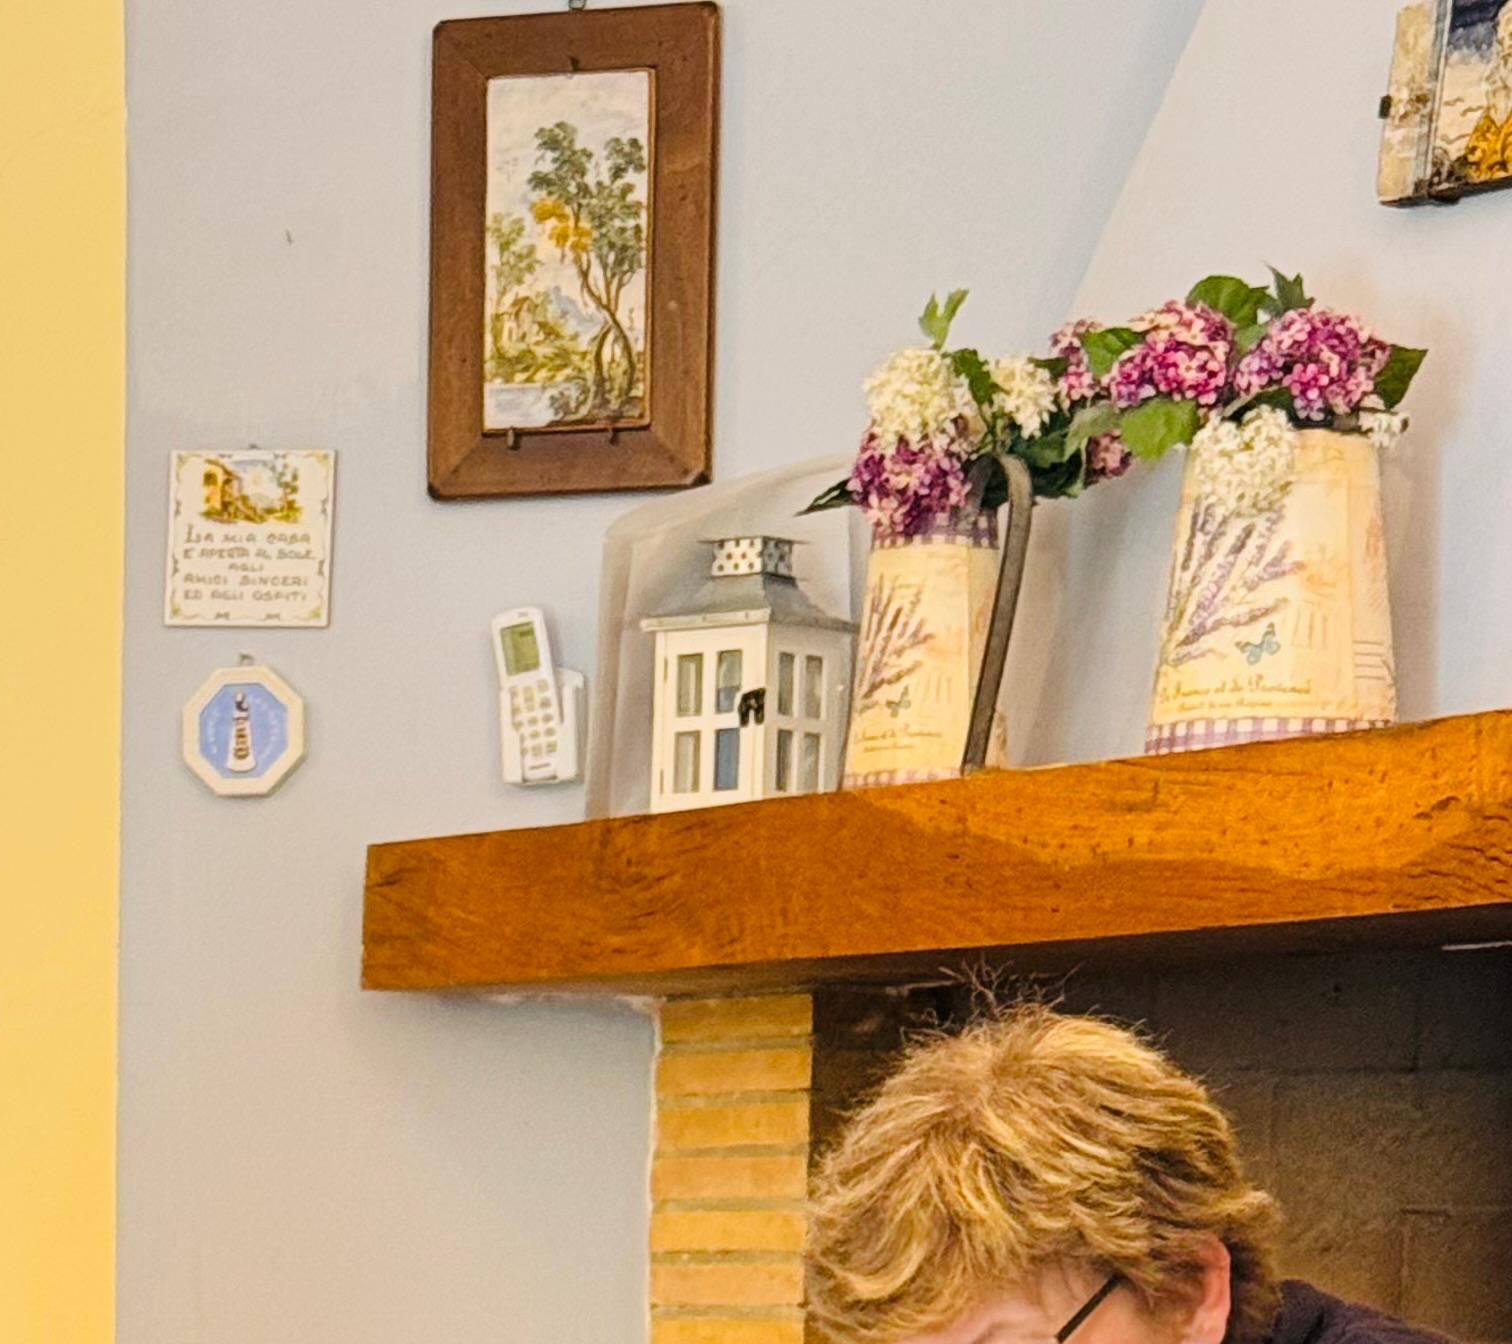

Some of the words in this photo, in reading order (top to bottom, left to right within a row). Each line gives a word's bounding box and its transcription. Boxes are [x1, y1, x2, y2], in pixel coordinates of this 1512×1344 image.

[183, 573, 228, 585] AMICI
[239, 574, 308, 586] SINCERI
[251, 589, 307, 601] OSPITI
